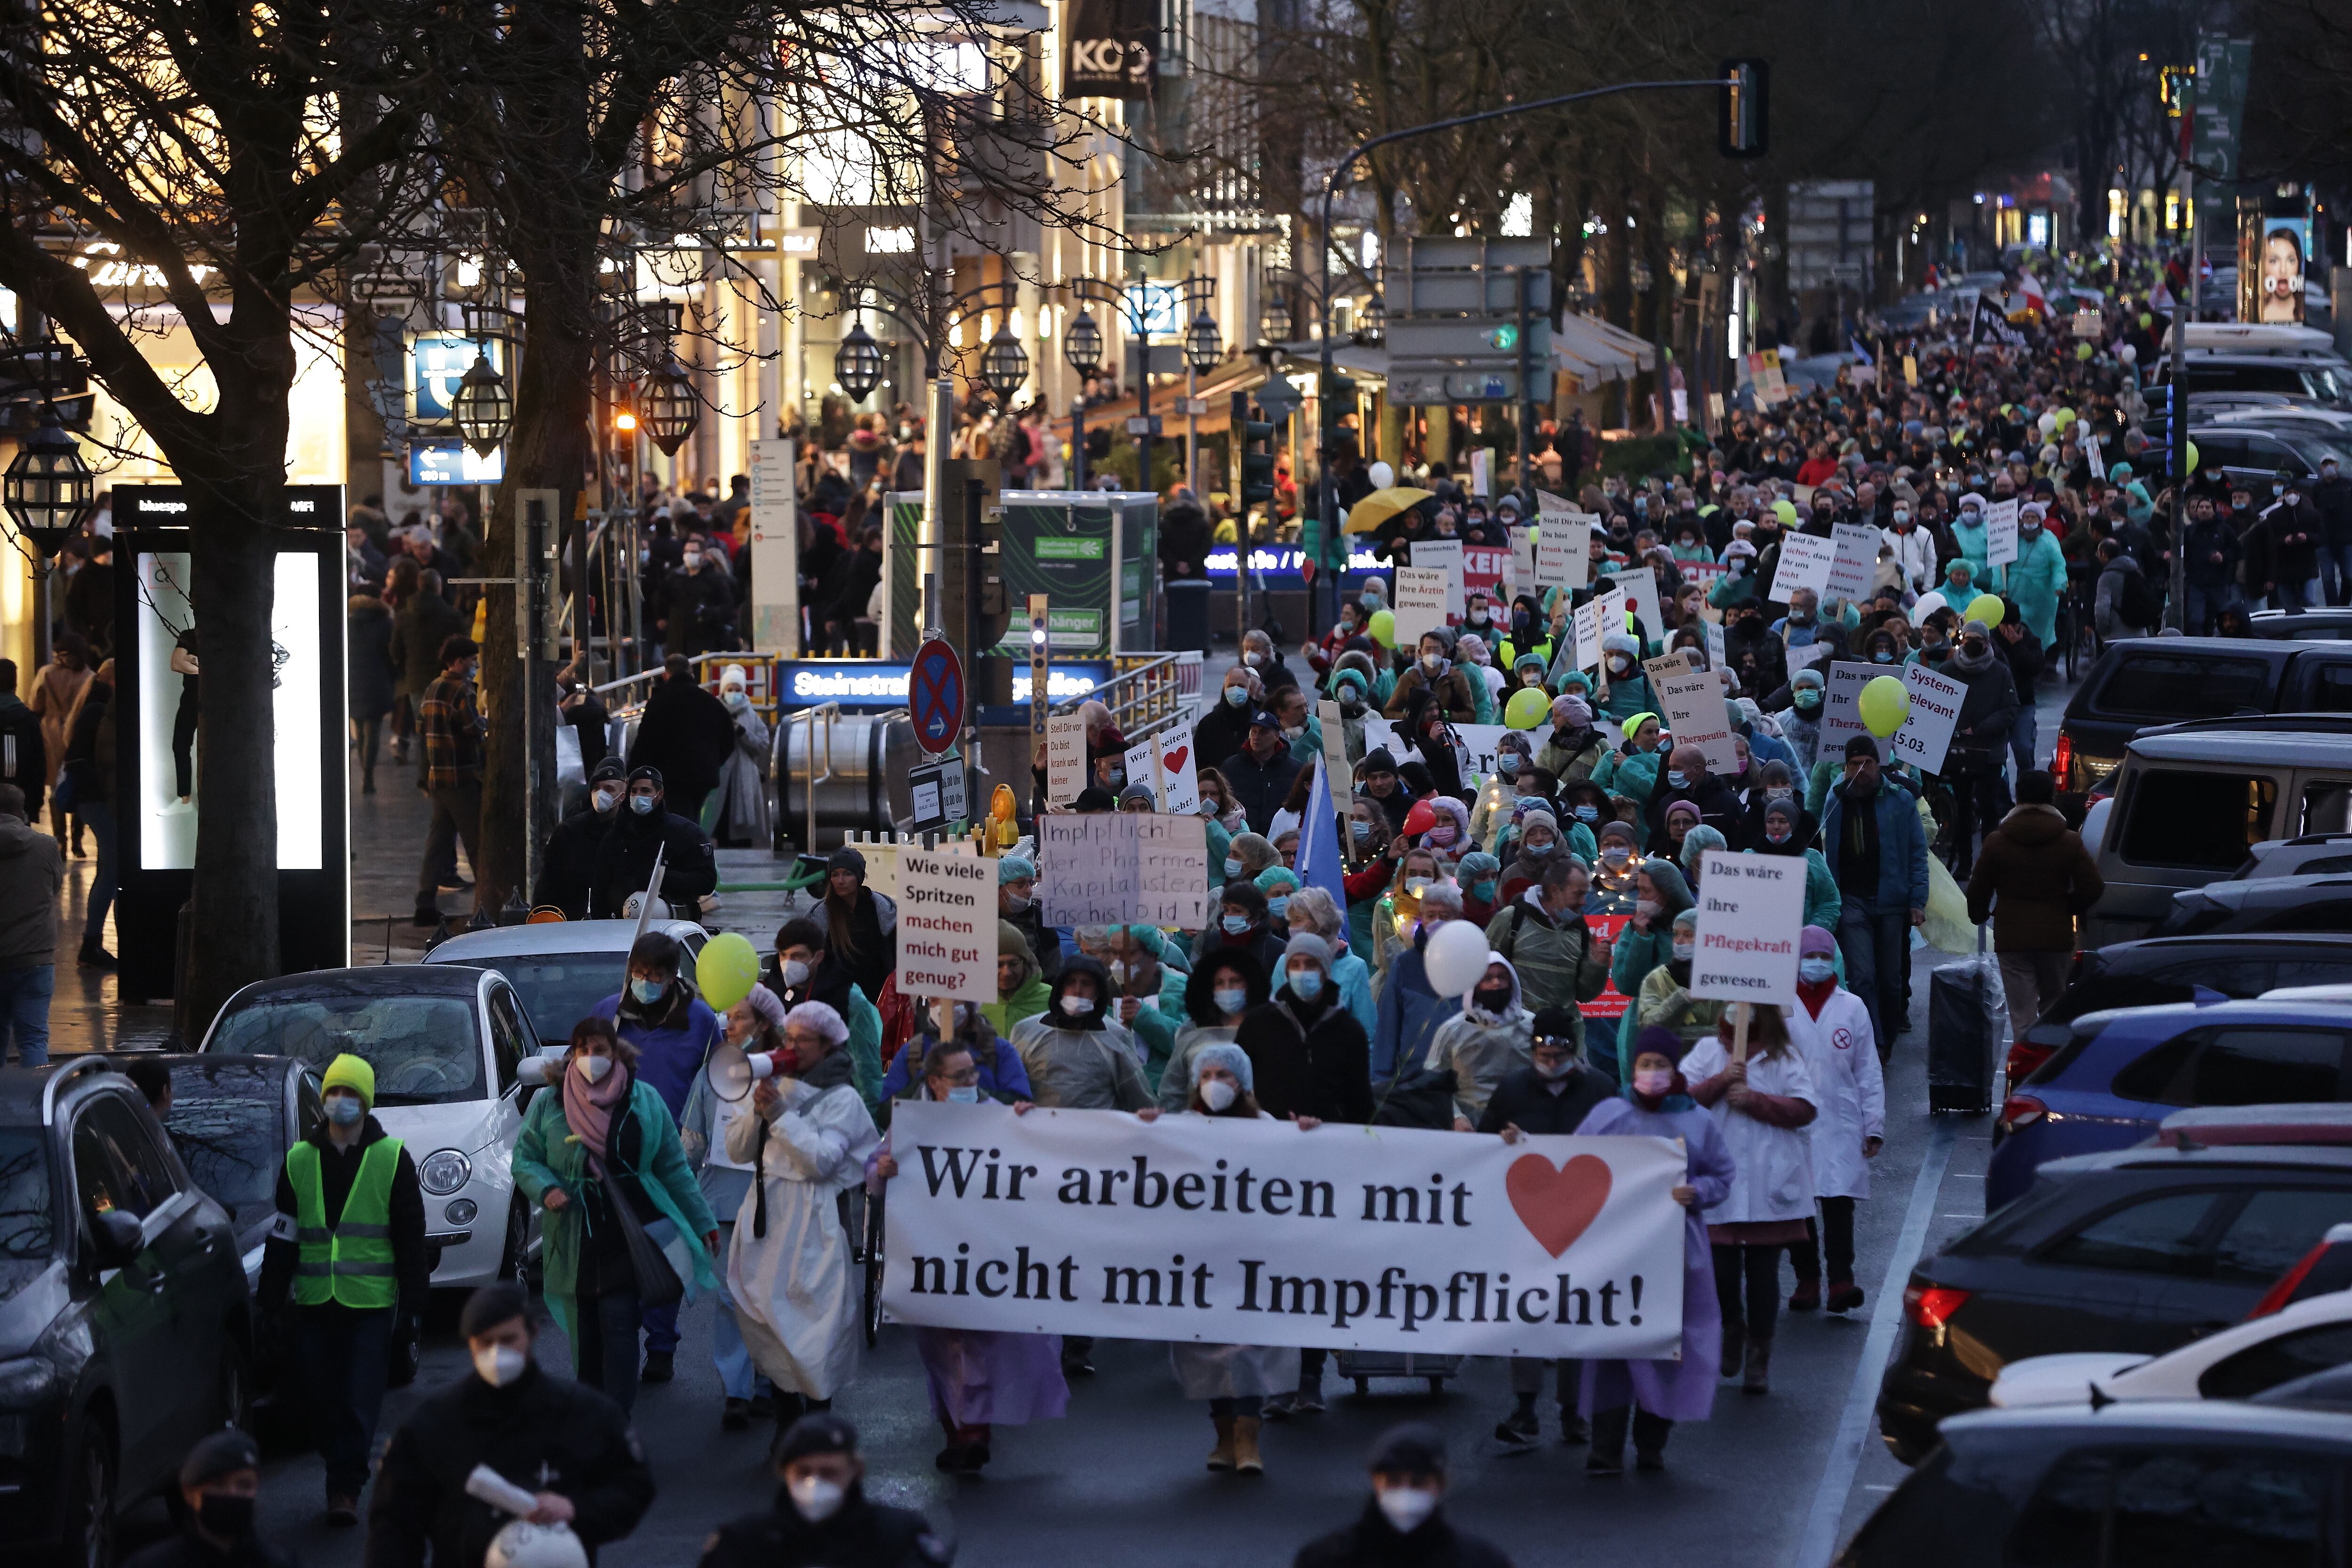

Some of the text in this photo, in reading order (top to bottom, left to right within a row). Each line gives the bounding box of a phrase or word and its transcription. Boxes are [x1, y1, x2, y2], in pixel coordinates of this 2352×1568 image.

[139, 500, 187, 514] bluespo
[1836, 527, 1870, 540] Das wäre
[1788, 534, 1819, 547] Seid ihr
[1813, 552, 1830, 561] dass
[1795, 561, 1809, 570] uns
[1400, 570, 1439, 580] Das wäre
[1779, 569, 1799, 580] nicht
[1399, 584, 1417, 593] Ihre
[1419, 584, 1444, 595] Ärztin
[1398, 600, 1439, 609] gewesen.
[1578, 606, 1591, 616] Wir
[1579, 615, 1591, 626] mit
[1648, 658, 1681, 672] Das wäre
[1835, 669, 1857, 680] Das
[1667, 682, 1705, 695] Das wäre
[1910, 669, 1959, 696] System-
[1832, 693, 1850, 704] Ihr
[1908, 692, 1955, 720] elevant
[1672, 711, 1690, 720] Ihre
[1050, 723, 1063, 734] Stell
[1073, 724, 1082, 732] vor
[1677, 730, 1727, 745] Therapeutin
[1892, 730, 1926, 755] 15.03.
[1051, 740, 1070, 751] Du bist
[1051, 756, 1078, 768] krank und
[1129, 752, 1147, 764] Wir
[1051, 775, 1068, 786] keiner
[1133, 772, 1149, 784] mit
[944, 794, 955, 807] 18.00
[1044, 850, 1078, 870] der
[906, 857, 985, 880] Wie viele
[1711, 861, 1783, 880] Das wäre
[906, 885, 975, 906] Spritzen
[1707, 897, 1740, 913] ihre
[906, 915, 973, 934] machen
[1704, 933, 1792, 954] Pflegekraft
[906, 941, 979, 963] mich gut
[905, 970, 966, 990] genug?
[1700, 973, 1771, 989] gewesen.
[917, 1145, 1473, 1227] Wir arbeiten mit
[910, 1242, 1645, 1332] nicht mit Impfpflicht!
